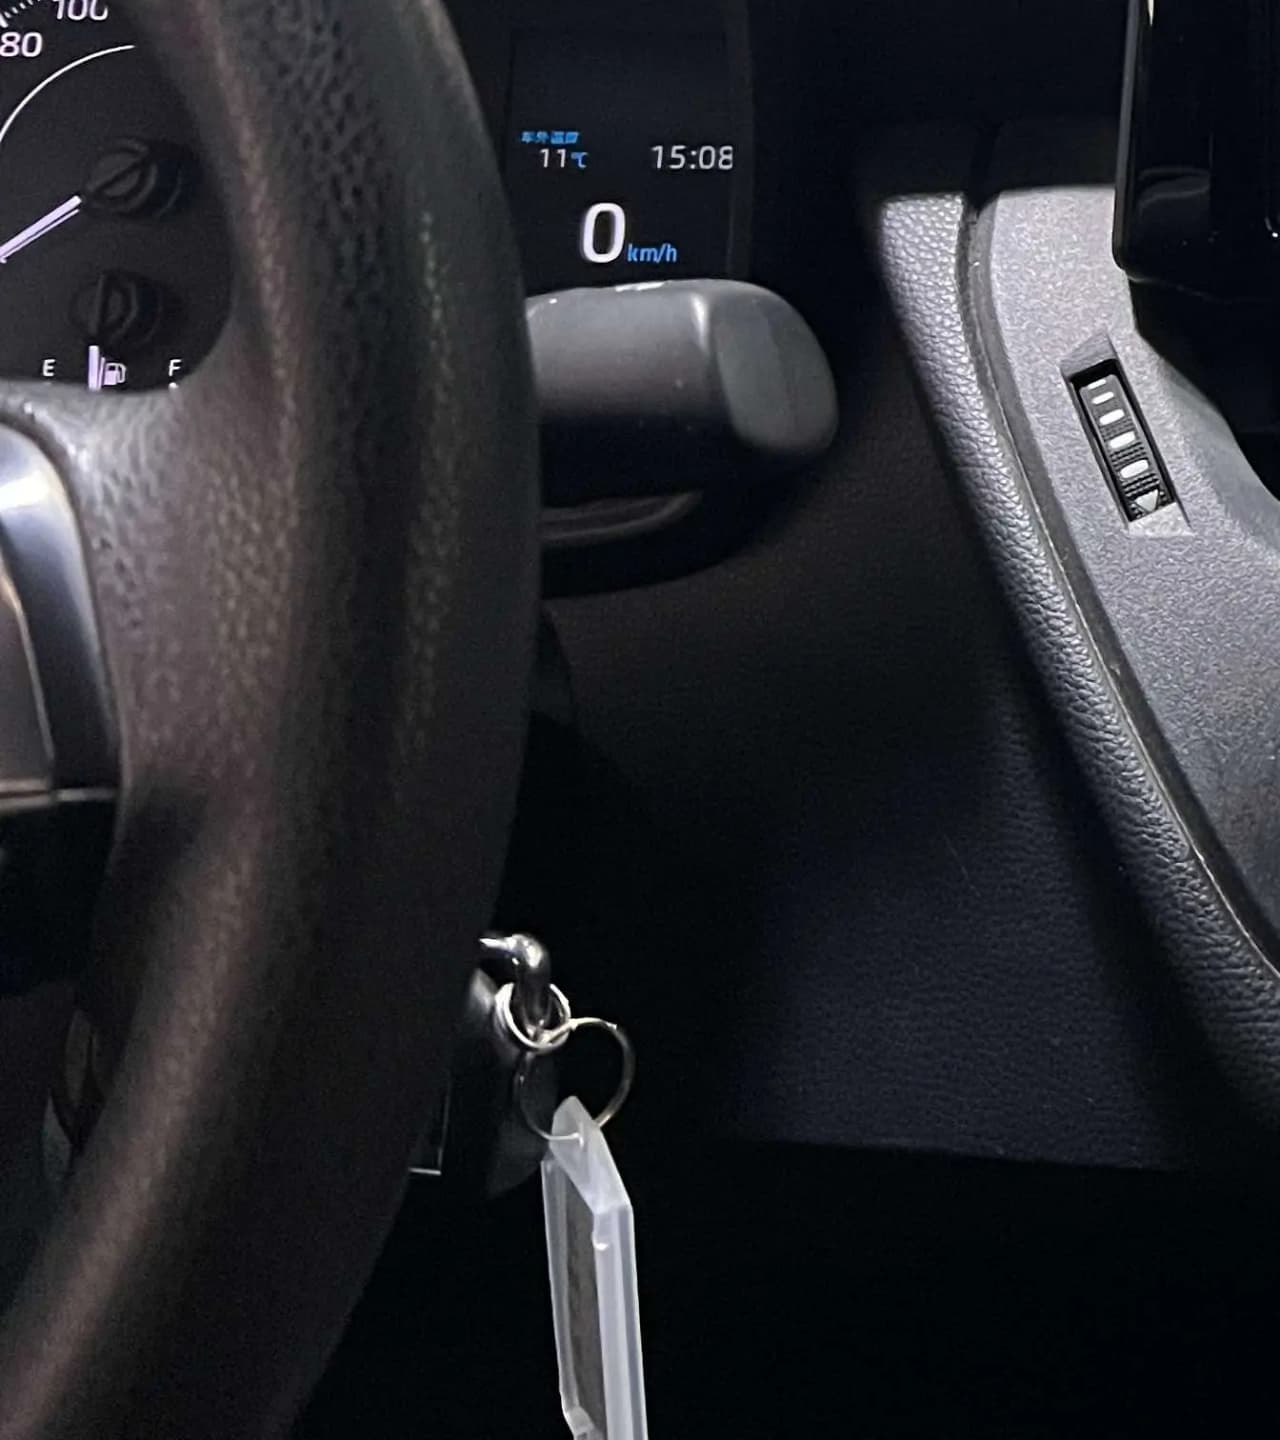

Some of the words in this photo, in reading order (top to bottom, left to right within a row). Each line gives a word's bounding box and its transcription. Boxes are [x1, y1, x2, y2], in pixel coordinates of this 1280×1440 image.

[0, 31, 43, 58] 80
[651, 145, 733, 170] 15:08
[582, 202, 626, 264] 0
[627, 243, 678, 263] km/h
[42, 359, 56, 377] E
[168, 359, 182, 377] F
